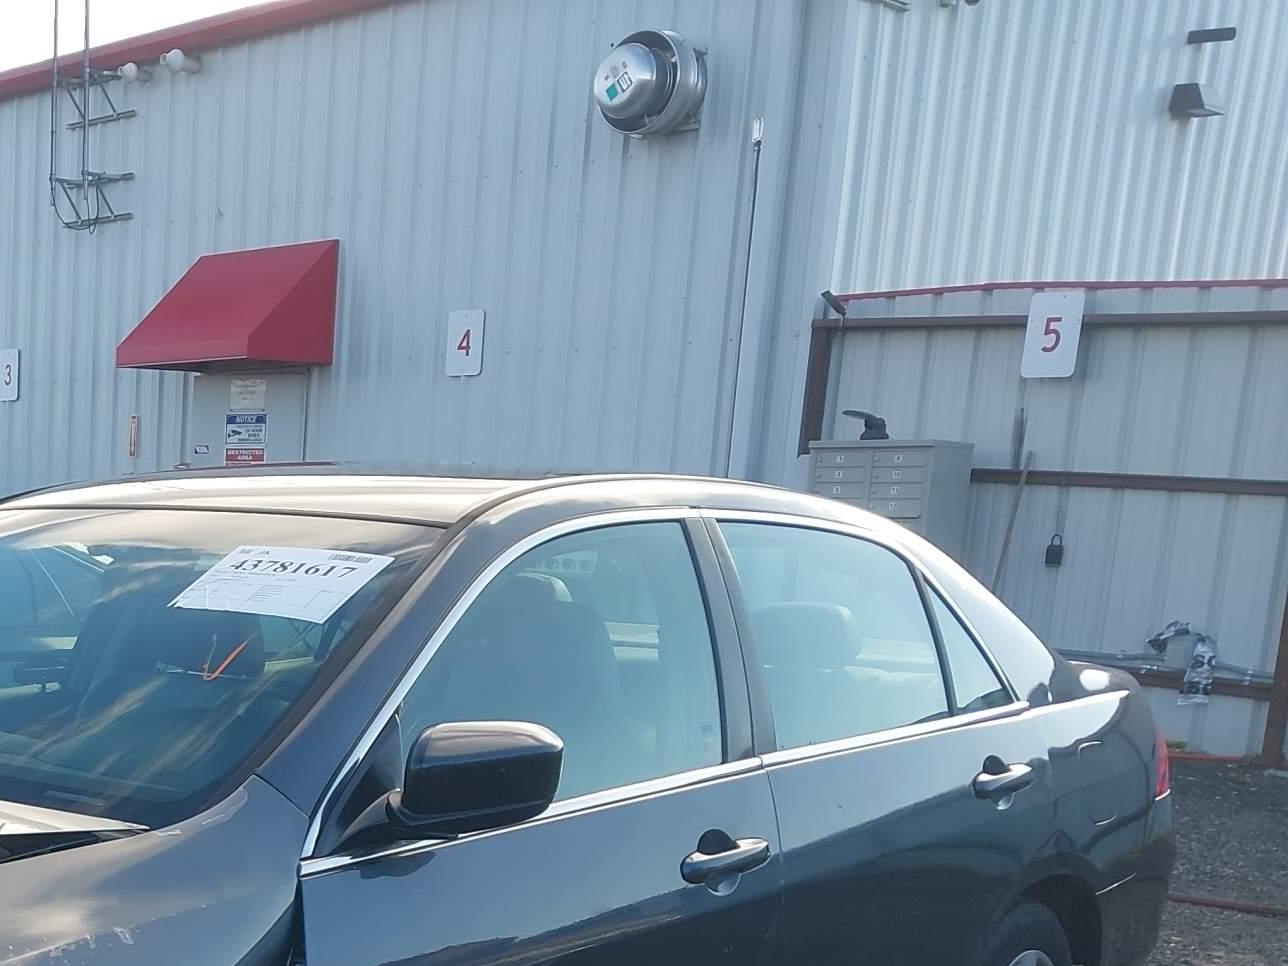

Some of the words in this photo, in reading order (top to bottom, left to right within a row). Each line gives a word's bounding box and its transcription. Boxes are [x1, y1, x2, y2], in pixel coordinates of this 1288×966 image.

[456, 328, 472, 357] 4
[1040, 316, 1063, 353] 5
[4, 363, 12, 386] 3
[235, 415, 257, 424] NOTICE
[229, 558, 360, 579] 43781617
